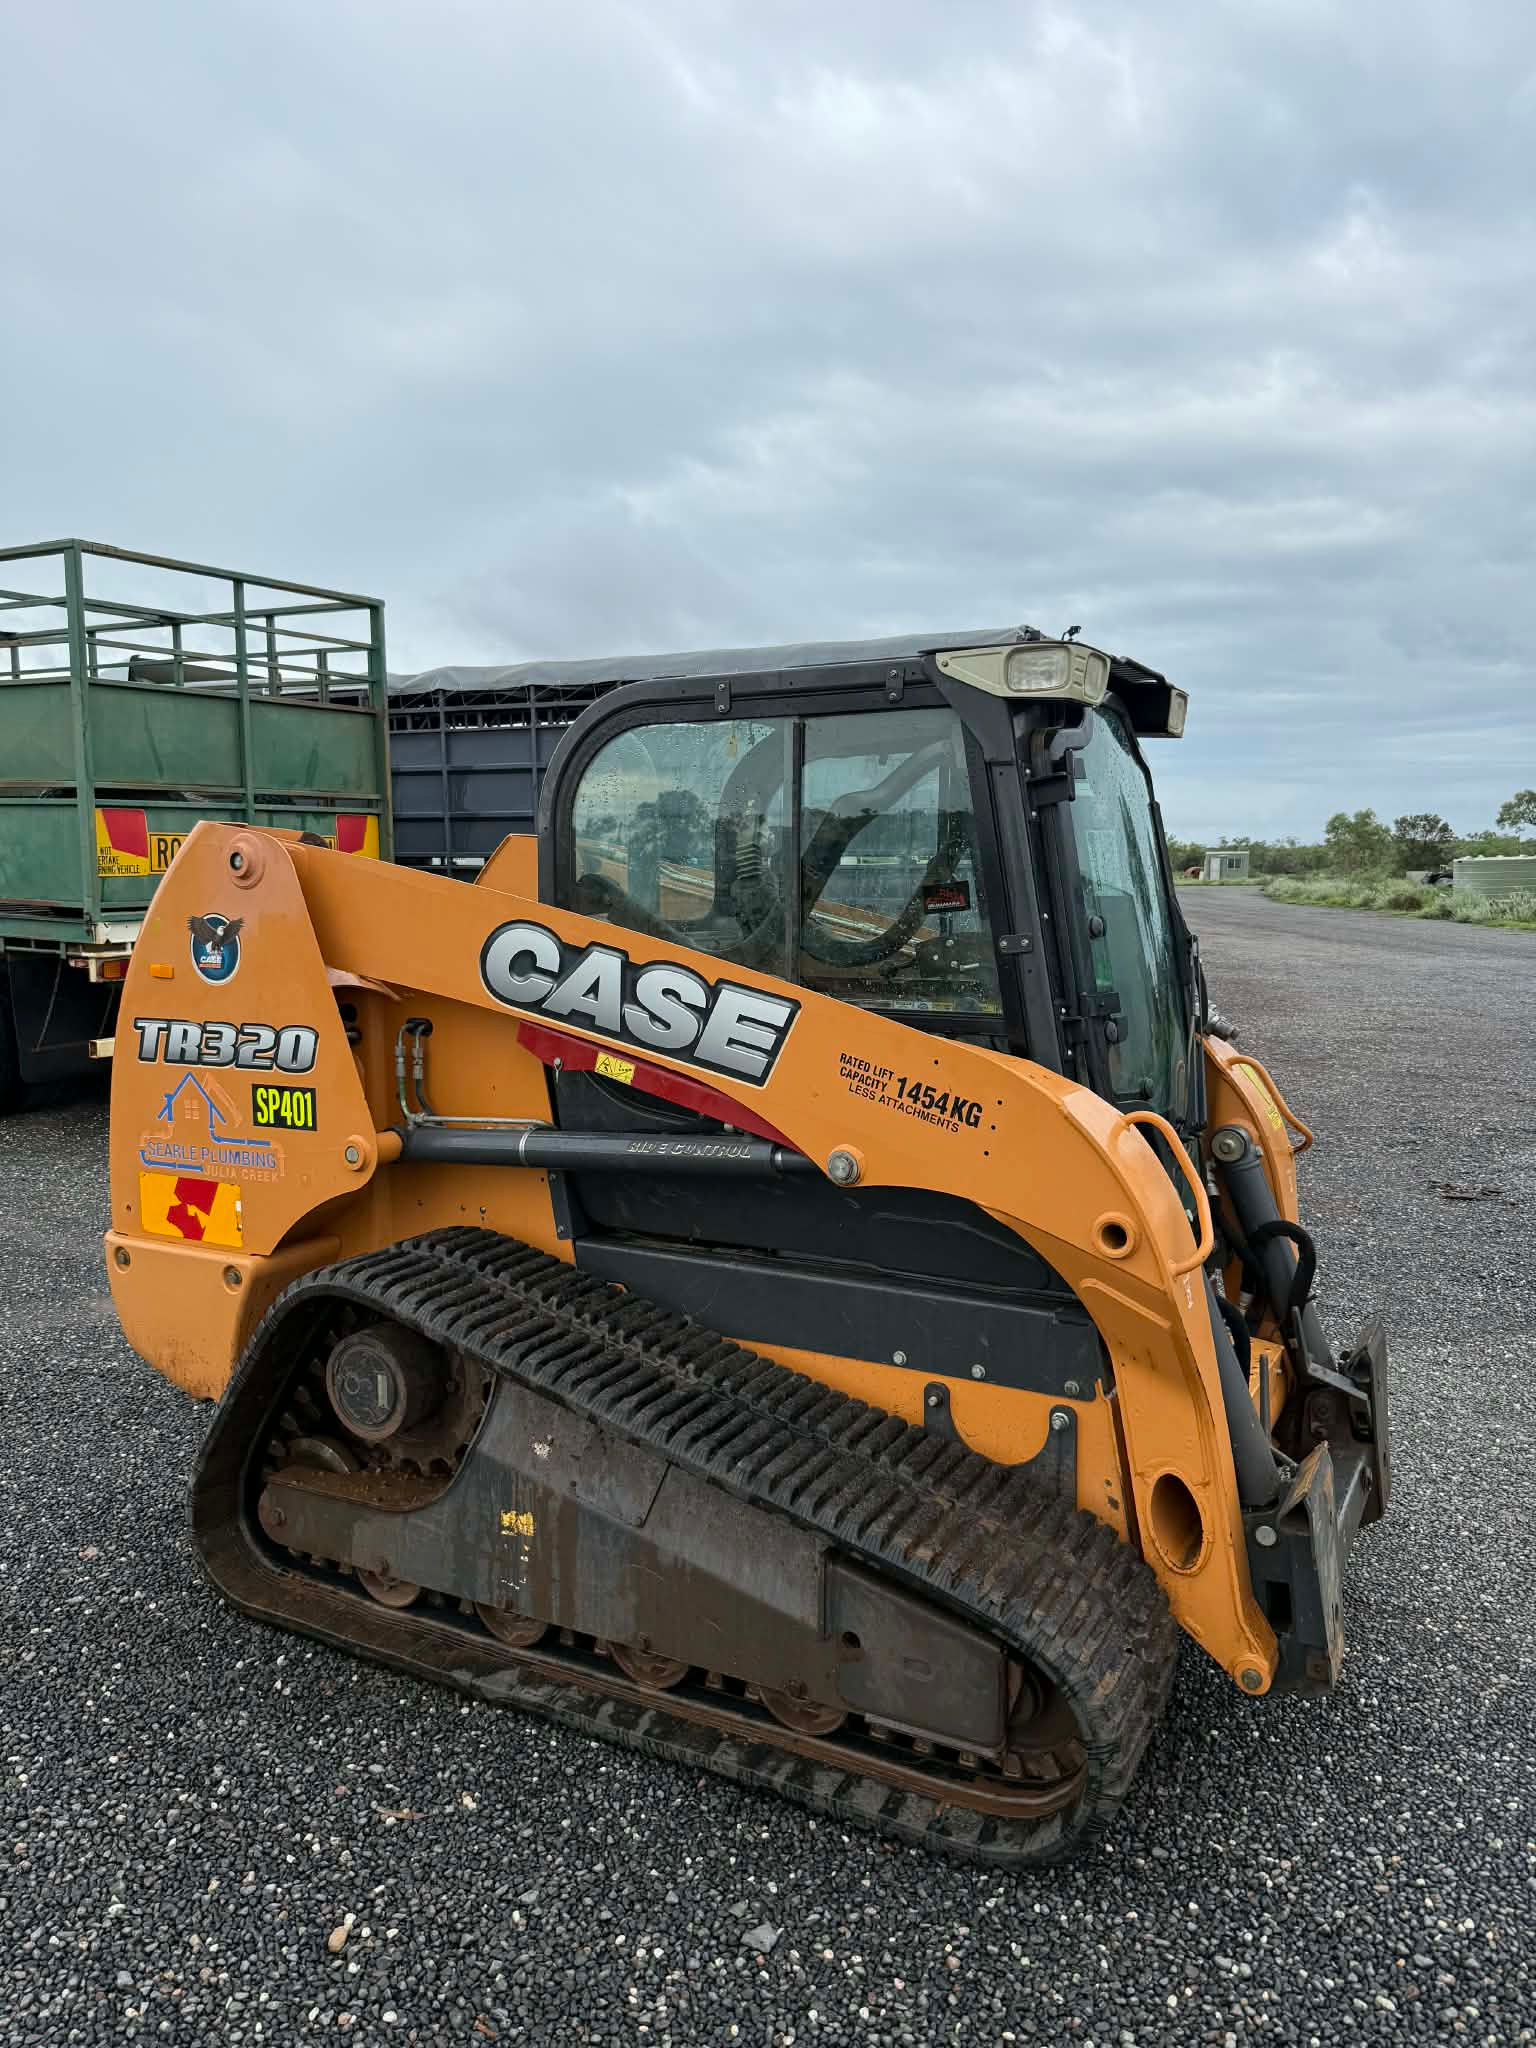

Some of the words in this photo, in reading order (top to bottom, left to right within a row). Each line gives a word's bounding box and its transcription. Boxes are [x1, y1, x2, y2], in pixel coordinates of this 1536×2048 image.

[97, 855, 120, 865] ERTAKE
[157, 837, 182, 868] RO
[481, 919, 801, 1087] CASE
[134, 1017, 319, 1073] TR320
[840, 1053, 871, 1073] RATED
[873, 1065, 895, 1080] LIFT
[840, 1066, 888, 1092] CAPACITY
[256, 1087, 313, 1127] SP401
[848, 1082, 876, 1101] LESS
[878, 1094, 960, 1133] ATTACHMENTS
[147, 1142, 198, 1161] SEARLE
[200, 1146, 277, 1169] PLUMBING
[671, 1143, 751, 1158] CONTROL
[204, 1164, 238, 1178] JULIA
[241, 1168, 279, 1183] CREEK
